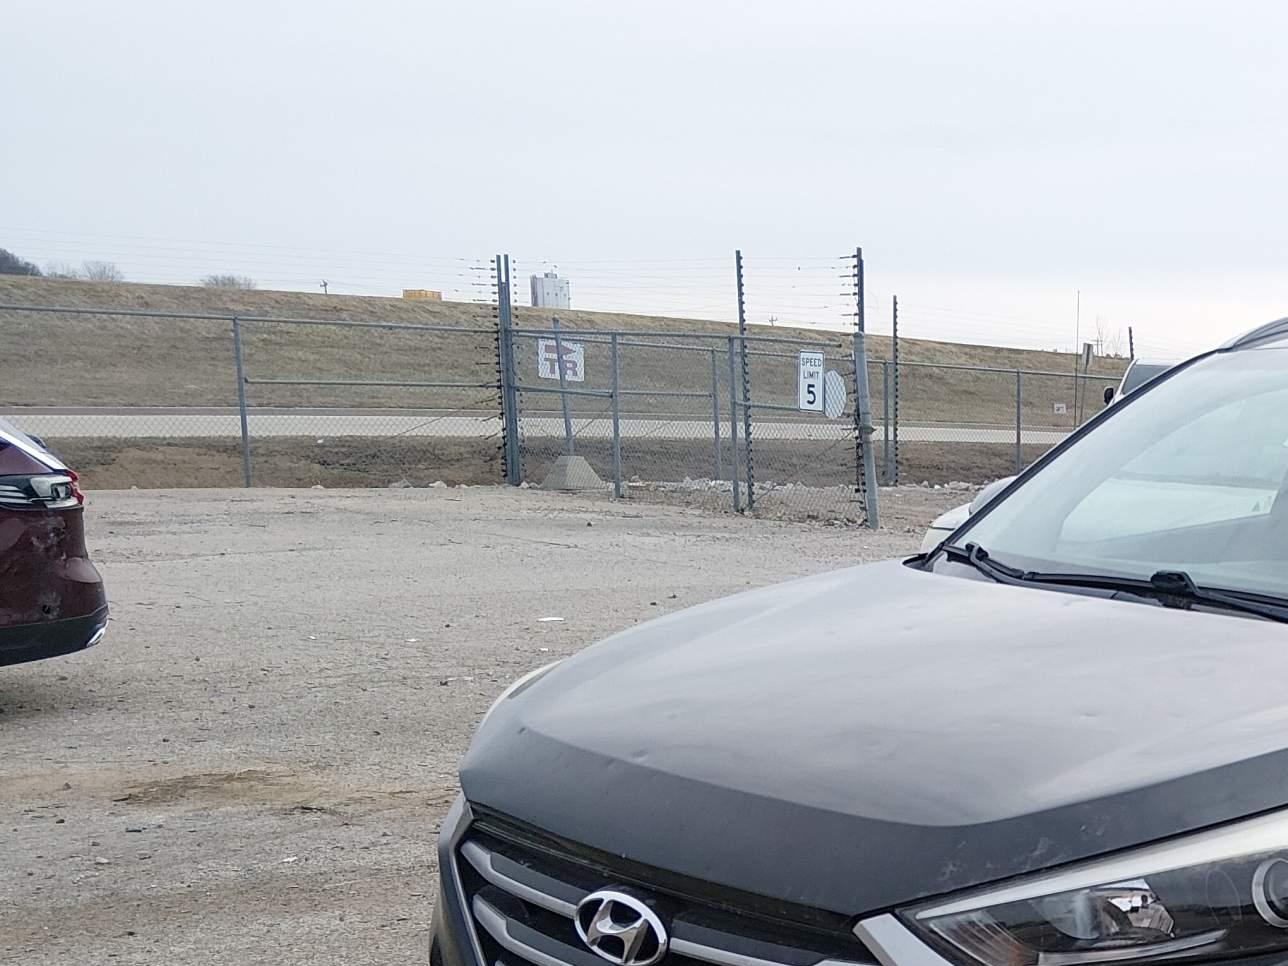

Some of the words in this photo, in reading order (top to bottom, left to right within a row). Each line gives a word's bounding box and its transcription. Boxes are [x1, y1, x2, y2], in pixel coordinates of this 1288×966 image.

[801, 357, 822, 367] SPEED
[803, 371, 820, 380] LIMIT
[806, 383, 817, 405] 5
